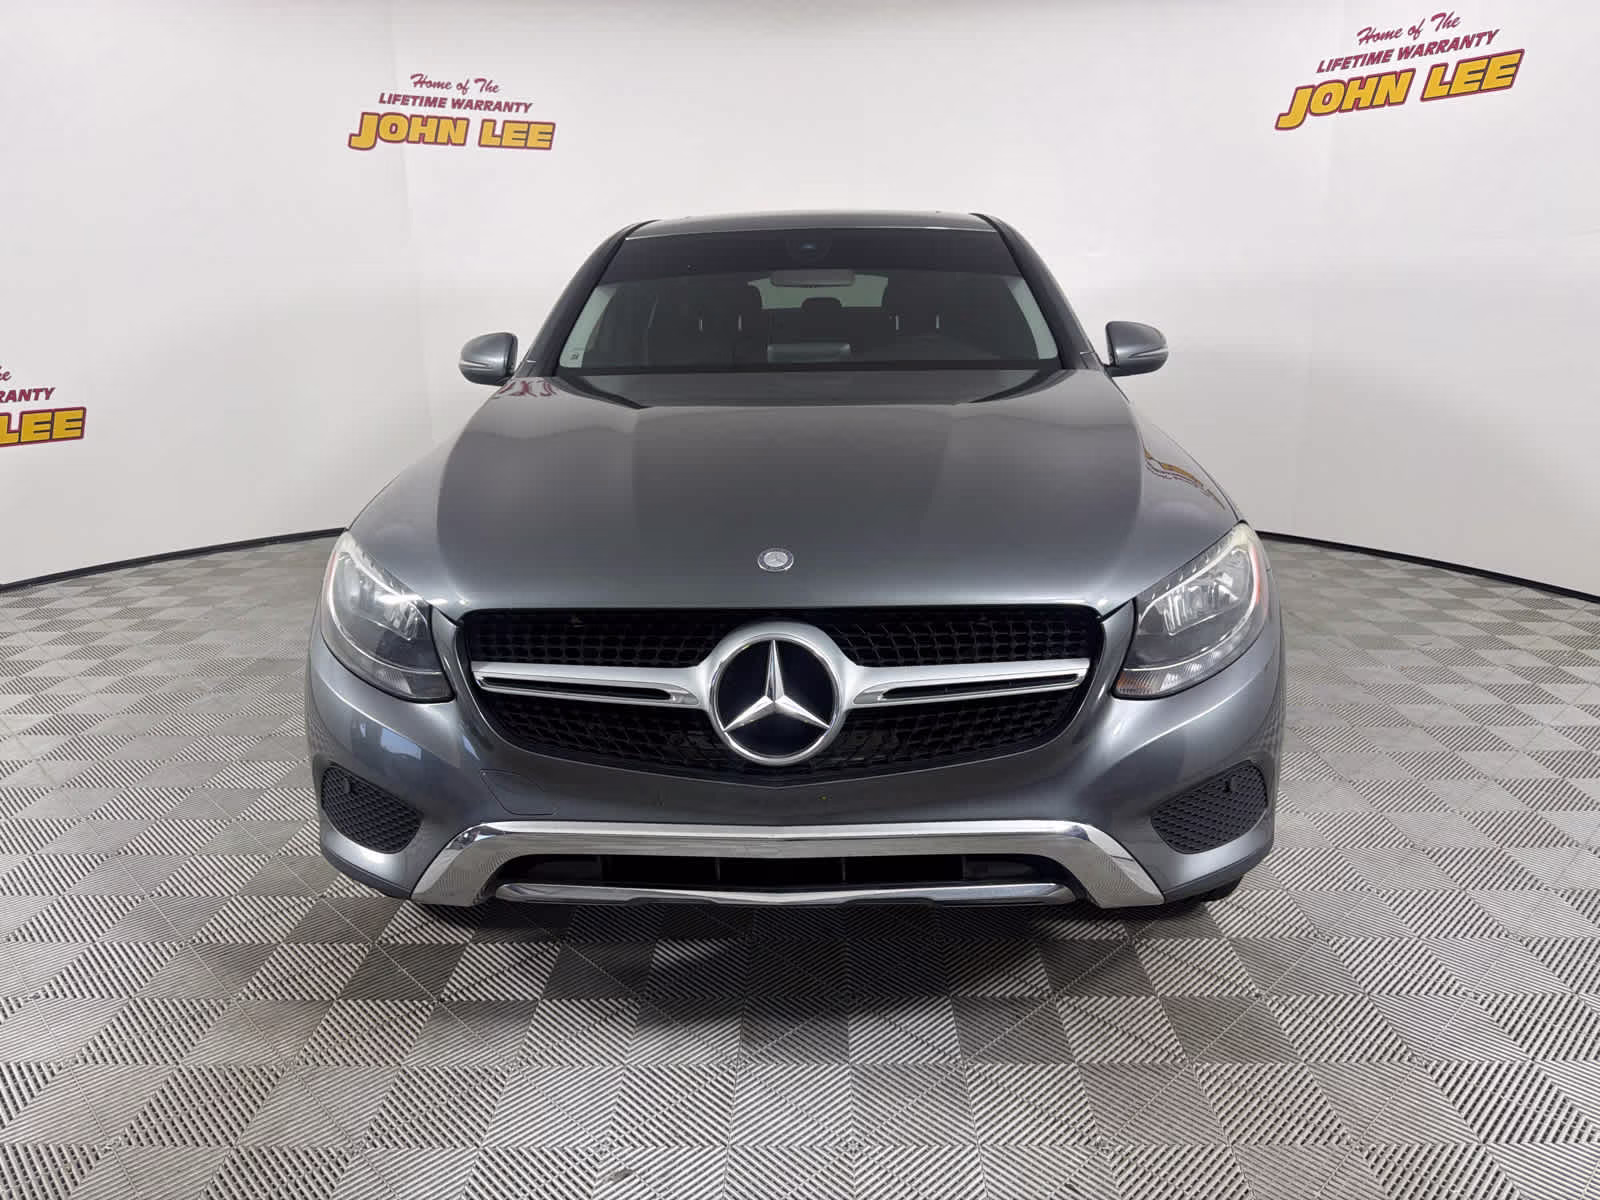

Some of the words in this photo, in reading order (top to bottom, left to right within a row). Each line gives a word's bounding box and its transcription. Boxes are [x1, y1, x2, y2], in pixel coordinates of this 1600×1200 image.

[1357, 26, 1403, 45] Home
[1407, 18, 1425, 41] of
[1430, 11, 1461, 31] The
[1316, 49, 1395, 73] LIFETIME
[1396, 29, 1500, 61] WARRANTY
[411, 73, 452, 90] Home
[456, 79, 470, 95] of
[474, 77, 500, 93] The
[1274, 68, 1416, 130] JOHN
[1420, 49, 1525, 102] LEE
[378, 93, 448, 108] LIFETIME
[451, 99, 533, 113] WARRANTY
[348, 112, 470, 151] JOHN
[478, 118, 556, 150] LEE
